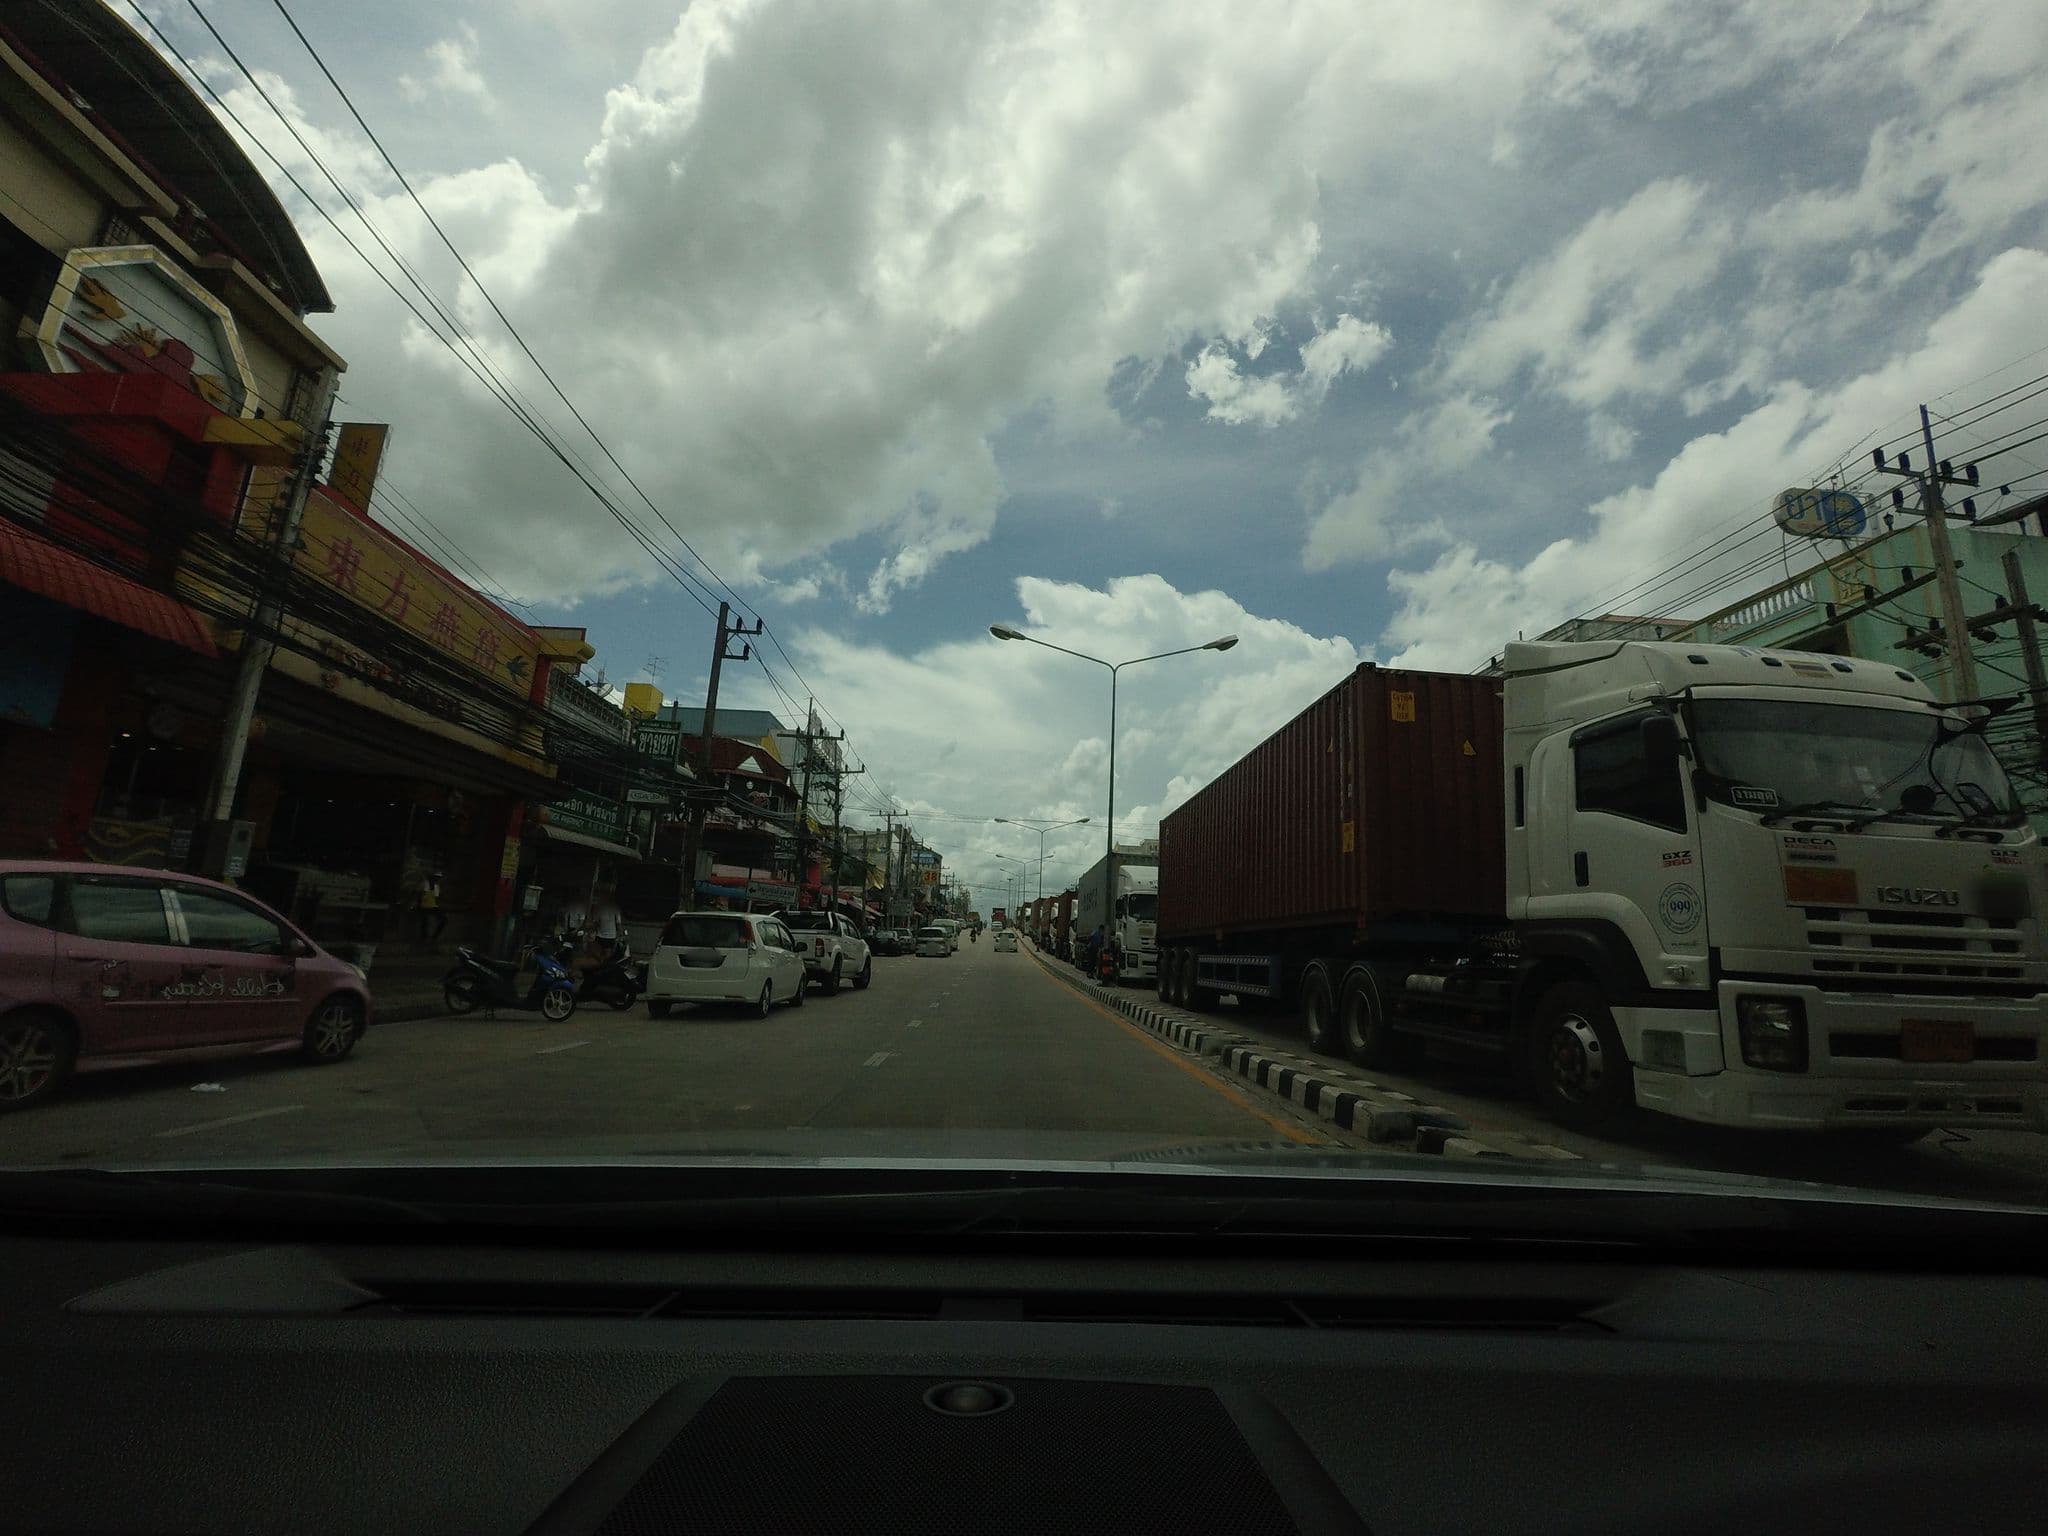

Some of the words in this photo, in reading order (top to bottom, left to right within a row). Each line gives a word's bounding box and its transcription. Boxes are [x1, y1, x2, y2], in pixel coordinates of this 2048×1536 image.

[1662, 851, 1692, 860] GXZ
[1877, 887, 1960, 906] ISUZU
[1670, 901, 1691, 914] 999
